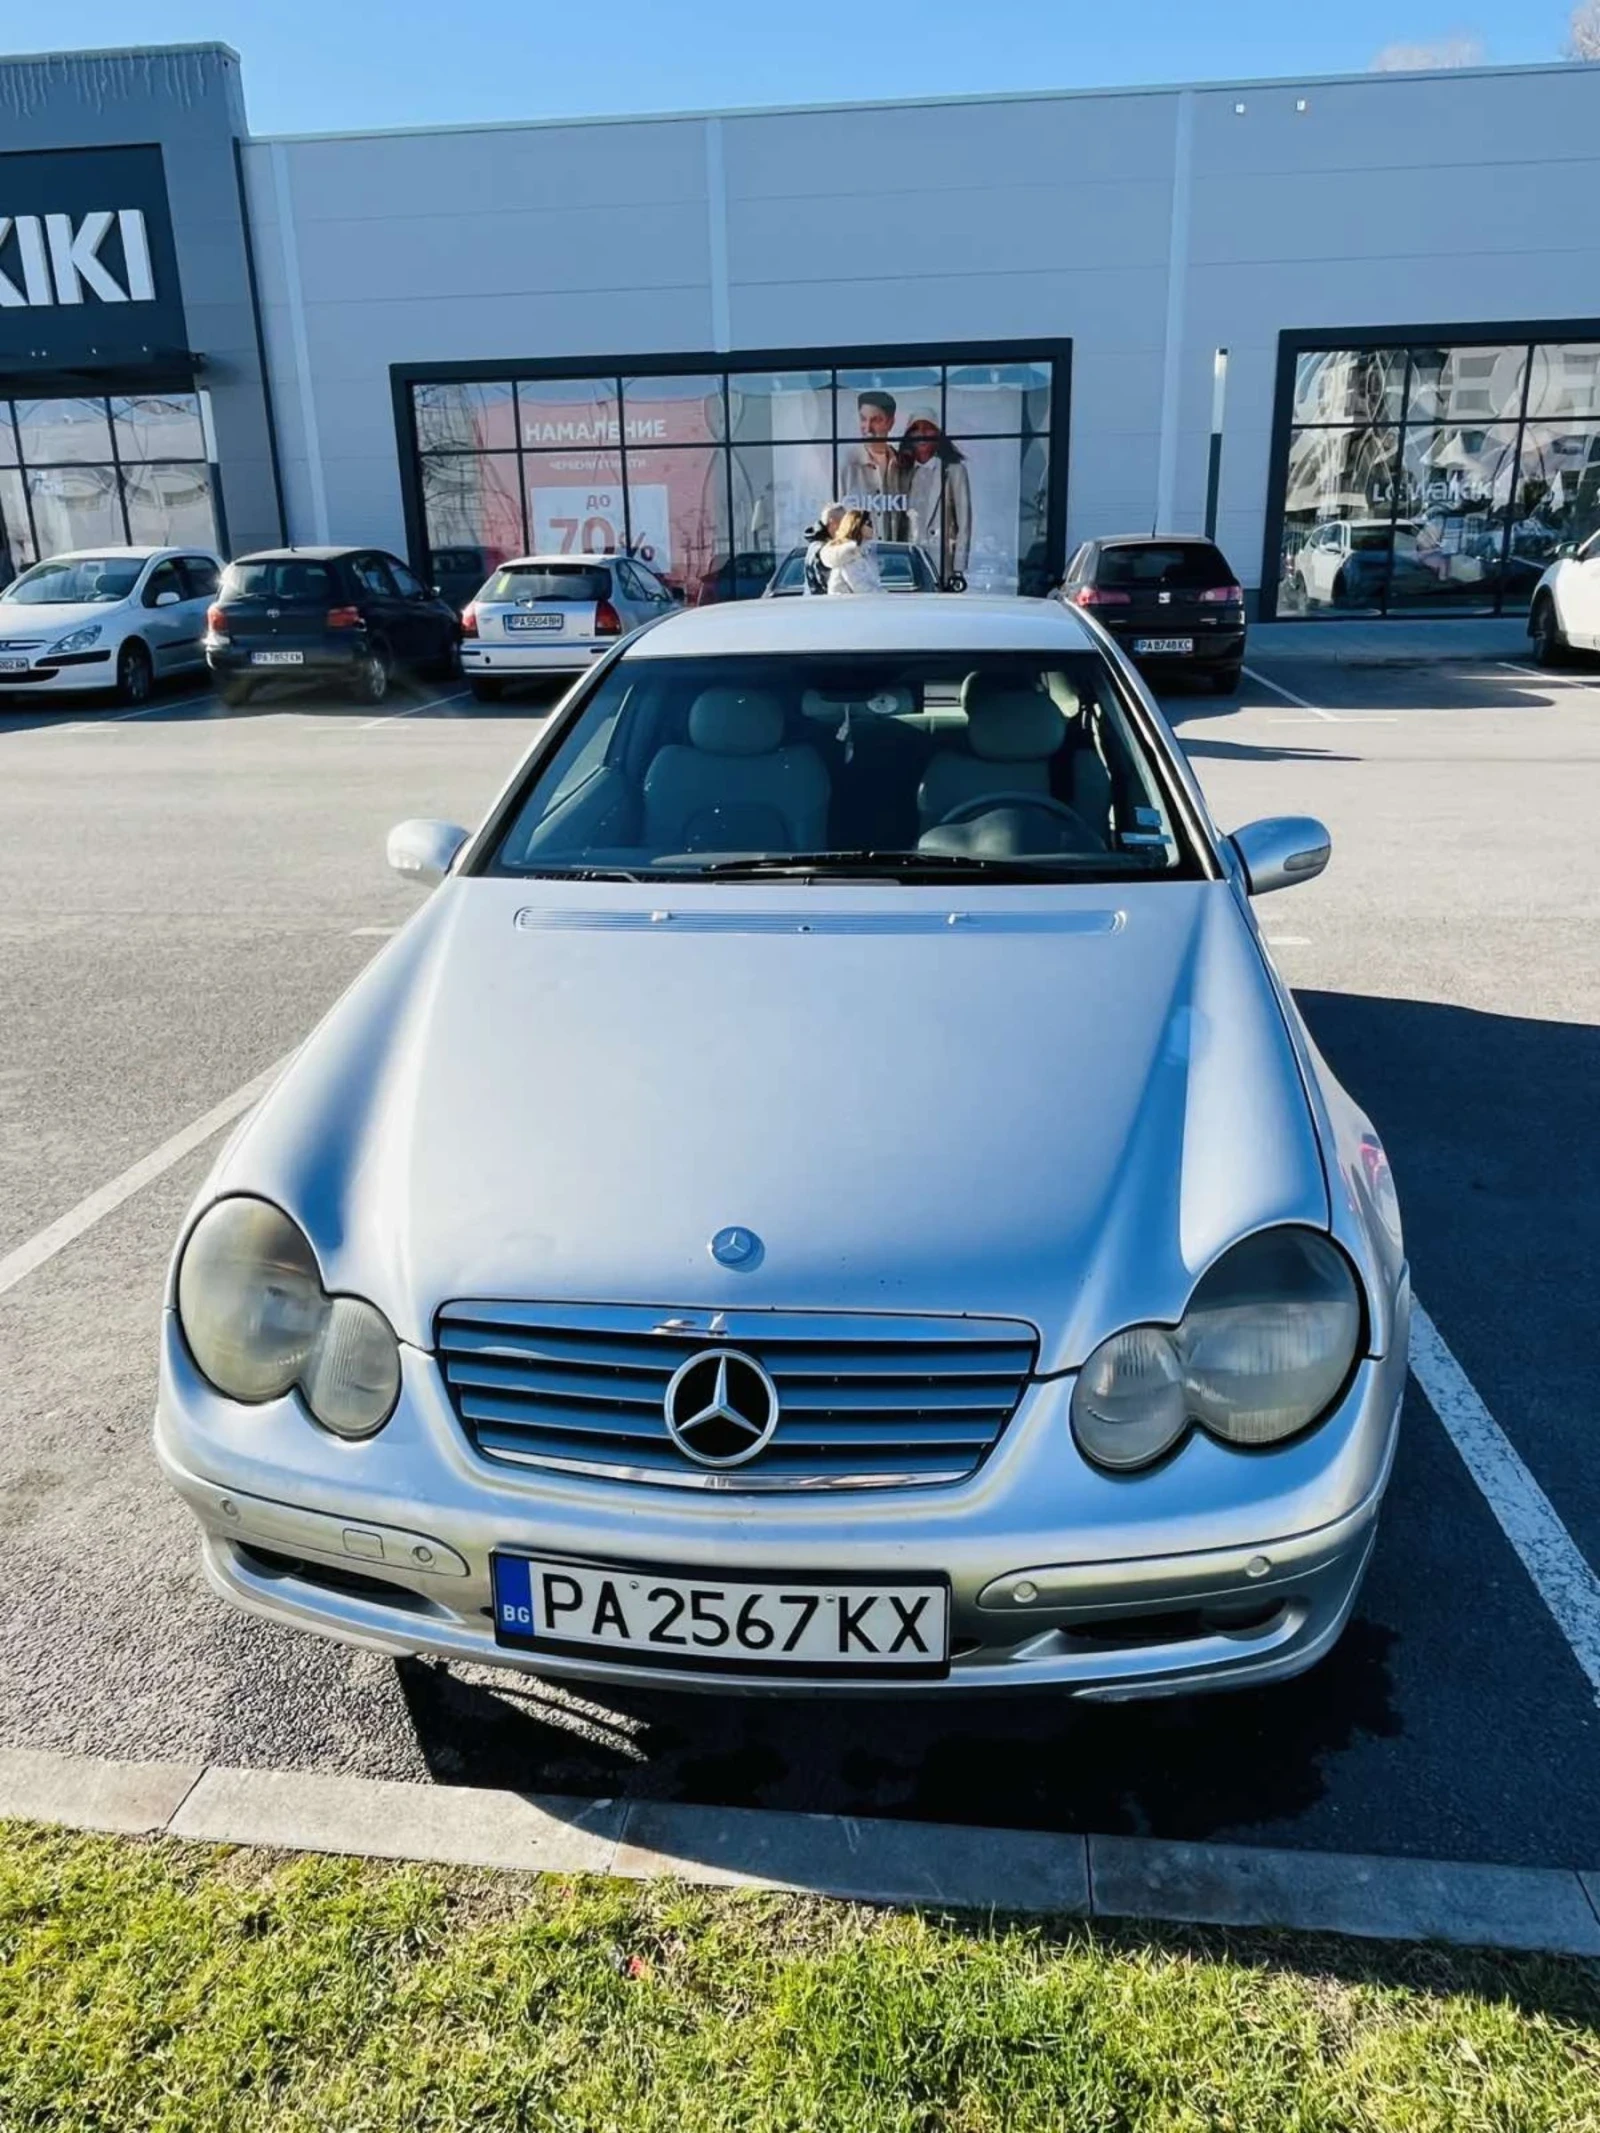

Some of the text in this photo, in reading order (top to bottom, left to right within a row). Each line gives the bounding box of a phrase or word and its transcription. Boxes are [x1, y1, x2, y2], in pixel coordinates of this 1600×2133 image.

[525, 420, 668, 442] НАМАЛЕНИЕ
[586, 494, 611, 510] ДО
[503, 1604, 530, 1624] BG
[542, 1573, 931, 1654] PA 2567 KX
